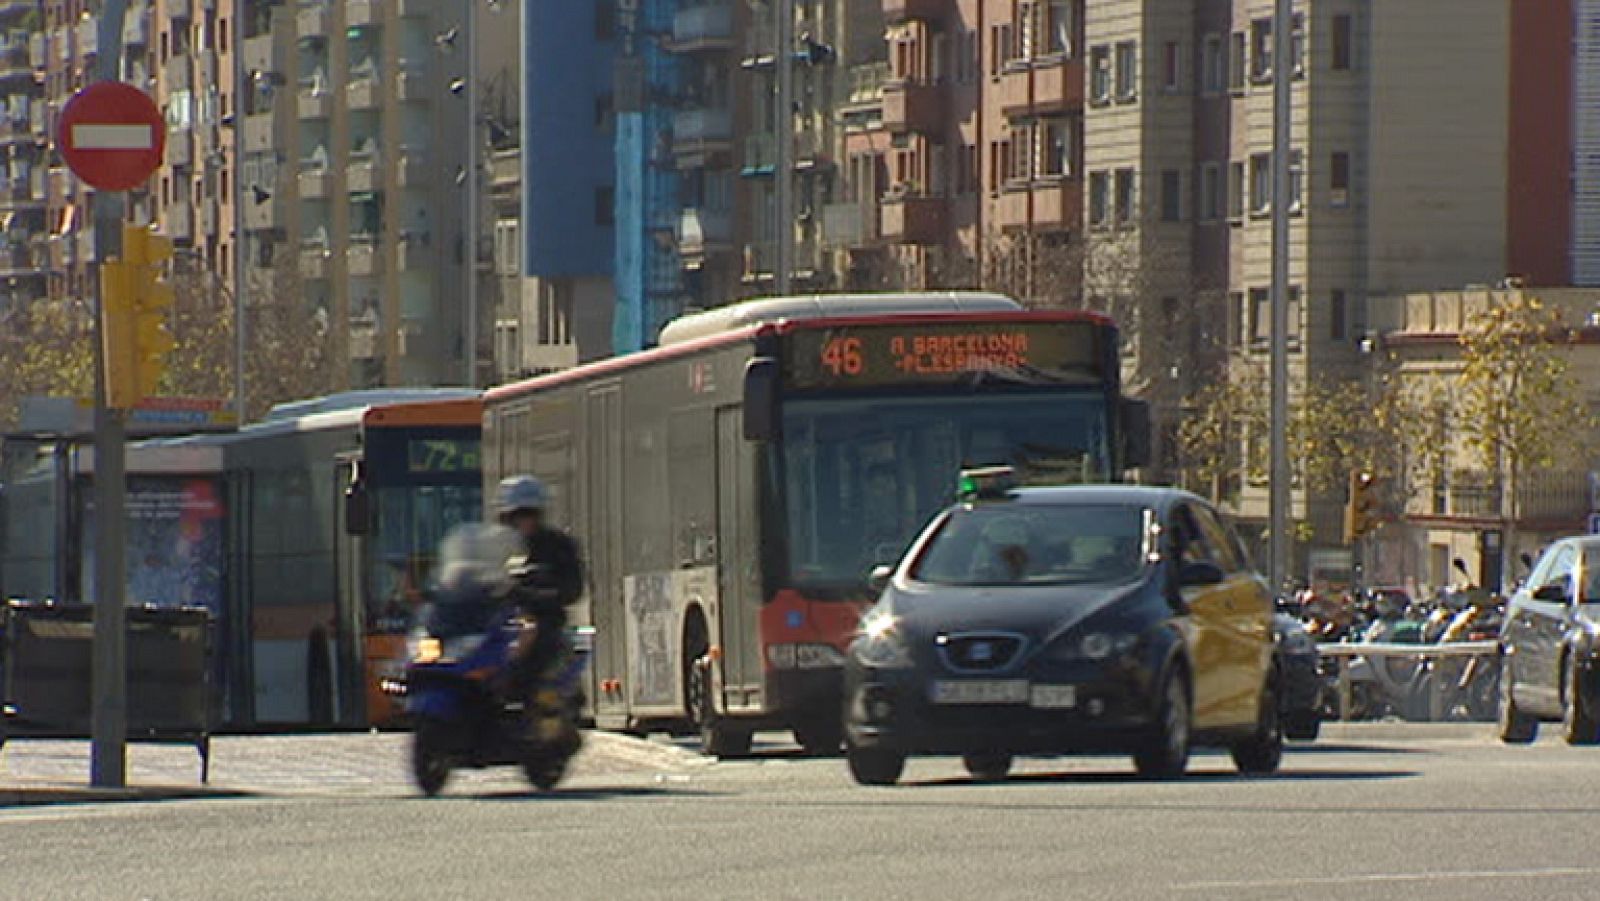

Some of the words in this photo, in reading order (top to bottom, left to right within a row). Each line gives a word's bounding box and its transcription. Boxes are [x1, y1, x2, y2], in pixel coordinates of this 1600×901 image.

[820, 338, 862, 375] 46
[891, 336, 905, 354] A
[912, 333, 1029, 354] BARCELONA
